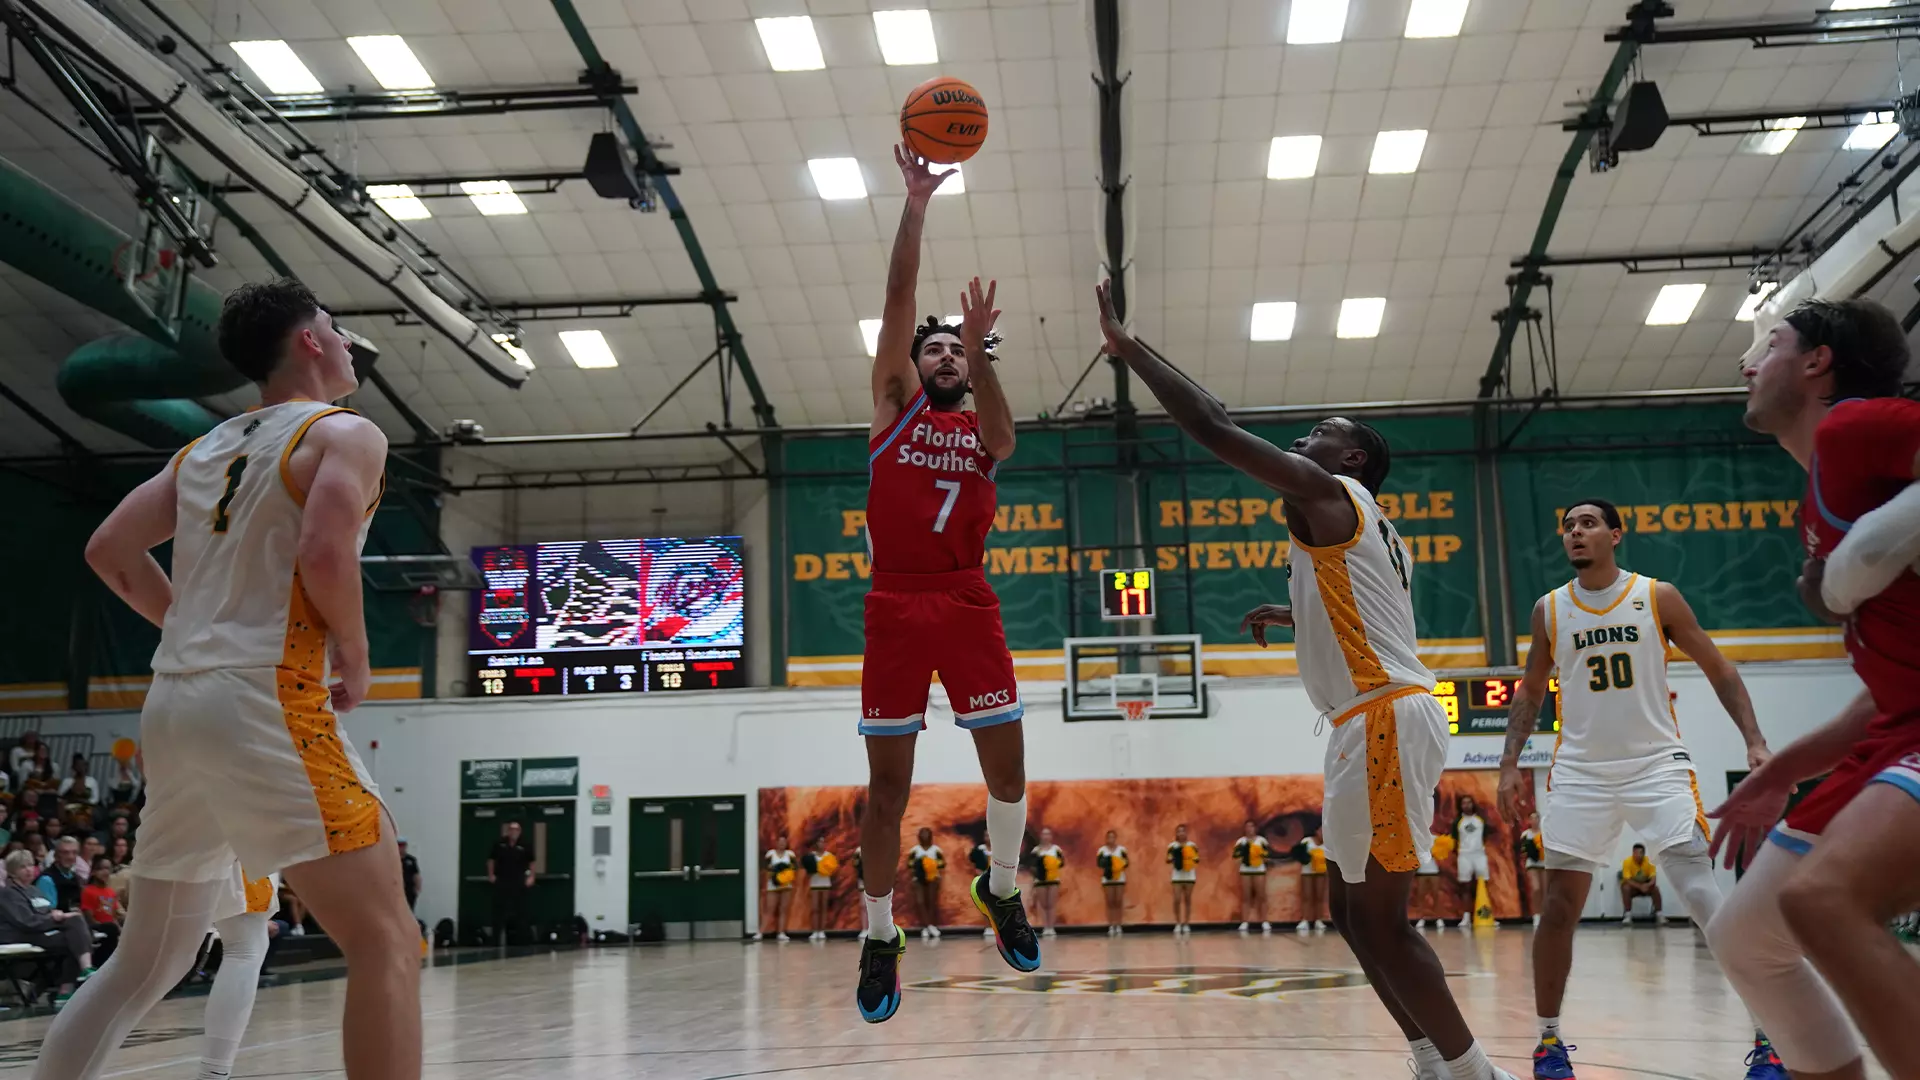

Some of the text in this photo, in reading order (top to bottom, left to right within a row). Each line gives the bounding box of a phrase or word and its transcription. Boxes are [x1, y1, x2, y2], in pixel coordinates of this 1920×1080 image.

[898, 444, 982, 474] Southe
[212, 454, 248, 534] 1
[932, 478, 961, 533] 7
[1121, 588, 1146, 616] 17
[1572, 625, 1640, 651] LIONS
[619, 674, 632, 690] 3
[660, 672, 682, 688] 10
[708, 671, 718, 687] 1
[1586, 652, 1634, 692] 30
[482, 678, 504, 694] 10
[530, 677, 540, 693] 1
[584, 675, 595, 691] 1
[969, 689, 1010, 710] MOCS
